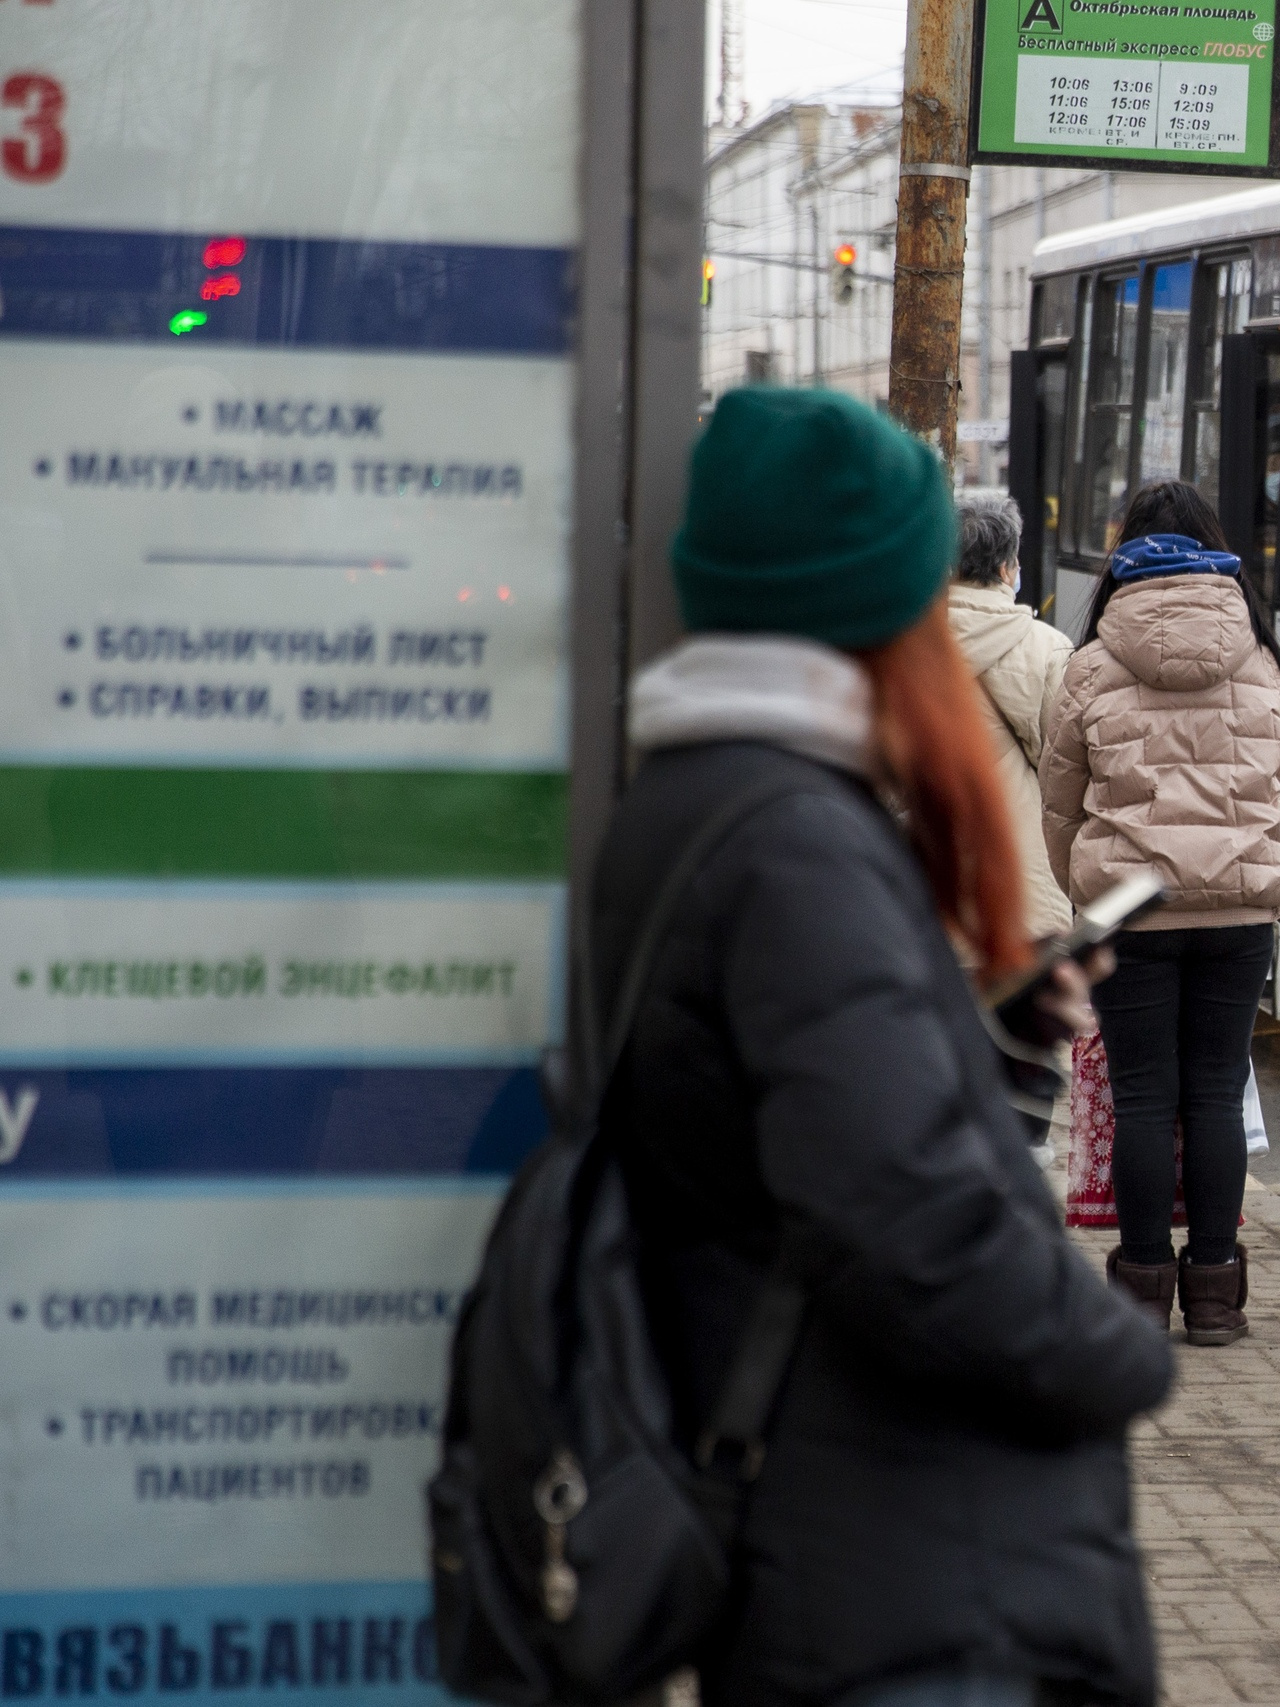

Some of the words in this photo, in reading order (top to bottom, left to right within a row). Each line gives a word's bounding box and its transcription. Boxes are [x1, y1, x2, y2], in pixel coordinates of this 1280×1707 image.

[1070, 1, 1180, 17] Октябрьская
[1183, 6, 1257, 21] площадь
[1018, 34, 1117, 52] Бесплатный
[1120, 42, 1200, 58] экспресс
[1203, 42, 1268, 59] ГЛОБУС
[1049, 94, 1088, 108] 11:06
[1111, 97, 1151, 110] 15:06
[1050, 77, 1090, 90] 10:06
[1113, 79, 1153, 93] 13:06
[1049, 112, 1088, 125] 12:06
[1107, 114, 1147, 128] 17:06
[1170, 117, 1210, 131] 15:09
[1173, 100, 1214, 113] 12:09
[213, 400, 383, 438] МАССАЖ
[66, 452, 338, 494] МАНУАЛЬНАЯ
[351, 459, 523, 498] ТЕРАПИЯ
[95, 622, 377, 665] БОЛЬНИЧНЫЙ
[387, 630, 488, 668] ЛИСТ
[89, 682, 284, 726] СПРАВКИ,
[301, 685, 492, 724] ВЫПИСКИ
[48, 954, 267, 1000] КЛЕЩЕВОЙ
[279, 960, 516, 1000] ЭНЦЕФАЛИТ
[41, 1291, 198, 1332] СКОРАЯ
[212, 1289, 470, 1330] МЕДИЦИНСК
[167, 1346, 349, 1387] ПОМОЩЬ
[135, 1457, 372, 1505] ПАЦИЕНТОВ
